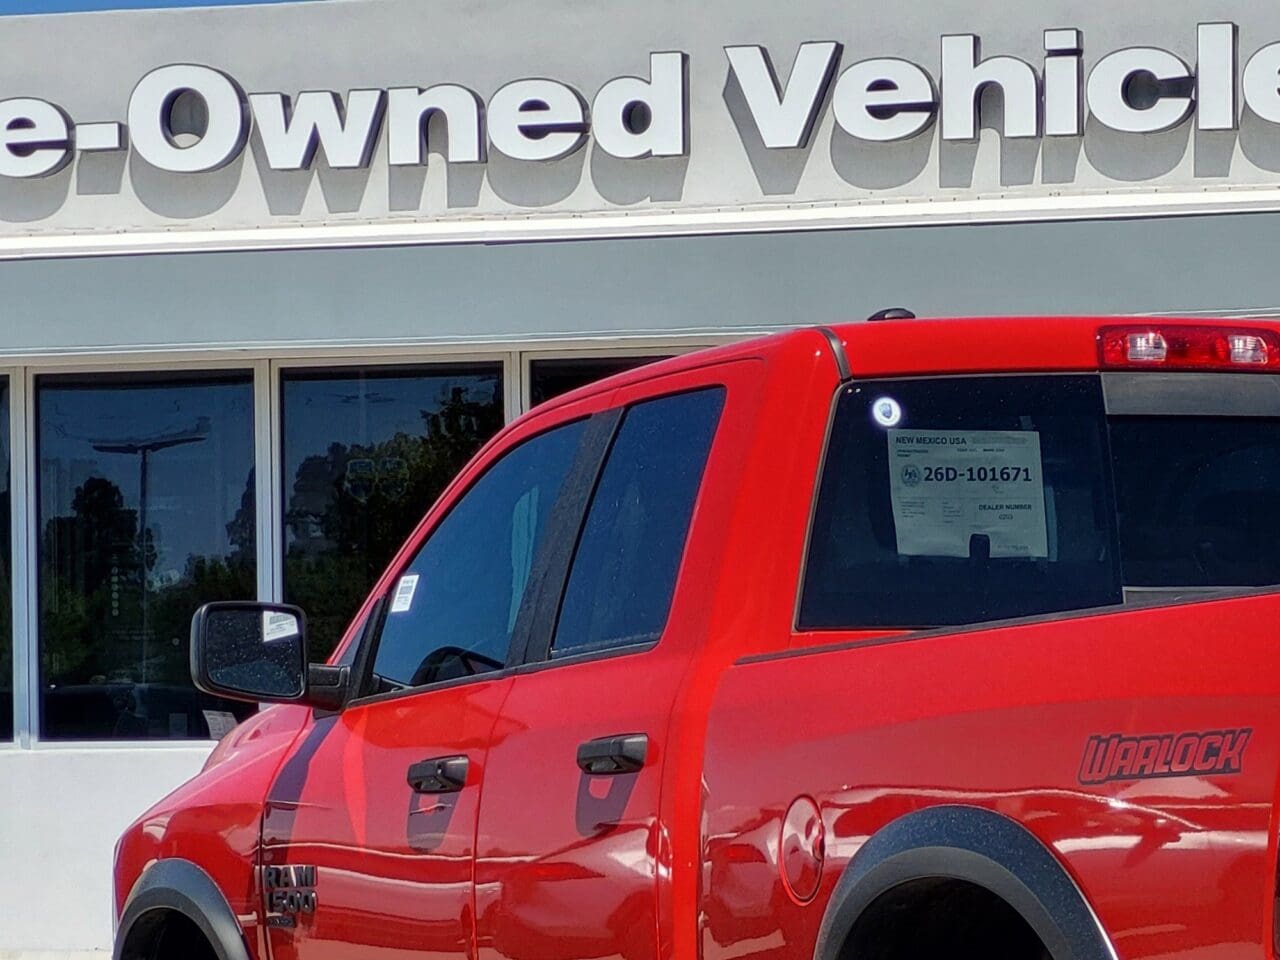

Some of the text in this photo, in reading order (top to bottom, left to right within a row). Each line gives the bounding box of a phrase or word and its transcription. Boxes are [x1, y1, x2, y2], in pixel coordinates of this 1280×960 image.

[895, 436, 967, 446] NEW MEXICO USA
[923, 466, 1033, 482] 26D-101671
[978, 503, 1005, 512] DEALER
[1079, 728, 1253, 785] WARLOCK
[265, 865, 317, 888] RAM
[265, 890, 318, 914] 1500
